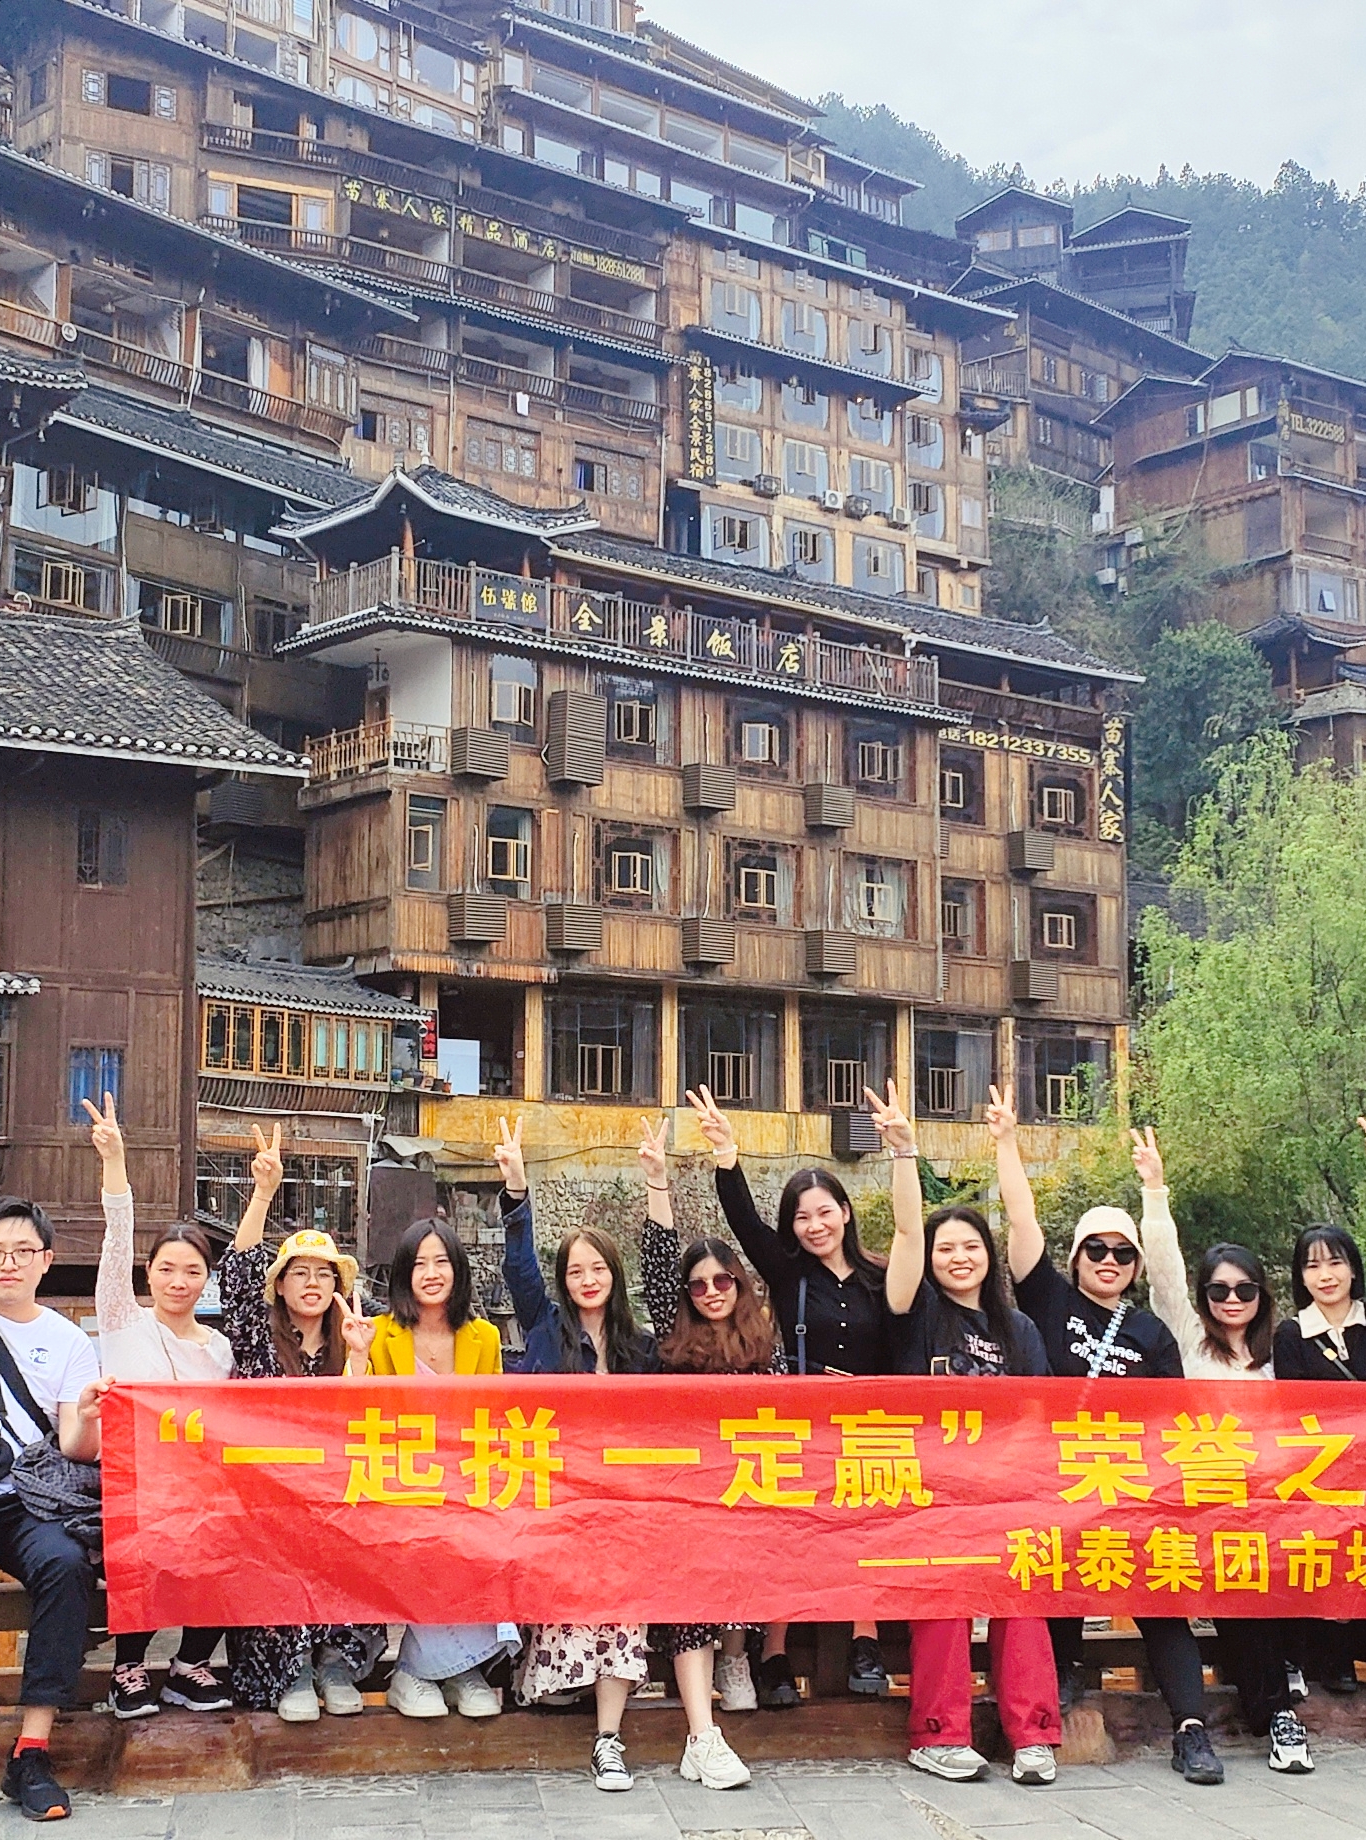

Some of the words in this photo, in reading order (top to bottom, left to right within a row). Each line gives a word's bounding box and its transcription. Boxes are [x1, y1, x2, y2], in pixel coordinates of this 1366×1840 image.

[704, 356, 714, 477] 18285512880
[571, 601, 803, 675] 全景饭店
[1099, 717, 1124, 840] 苗寨人家
[159, 1406, 564, 1511] “一起拼
[603, 1406, 982, 1509] 一定赢”
